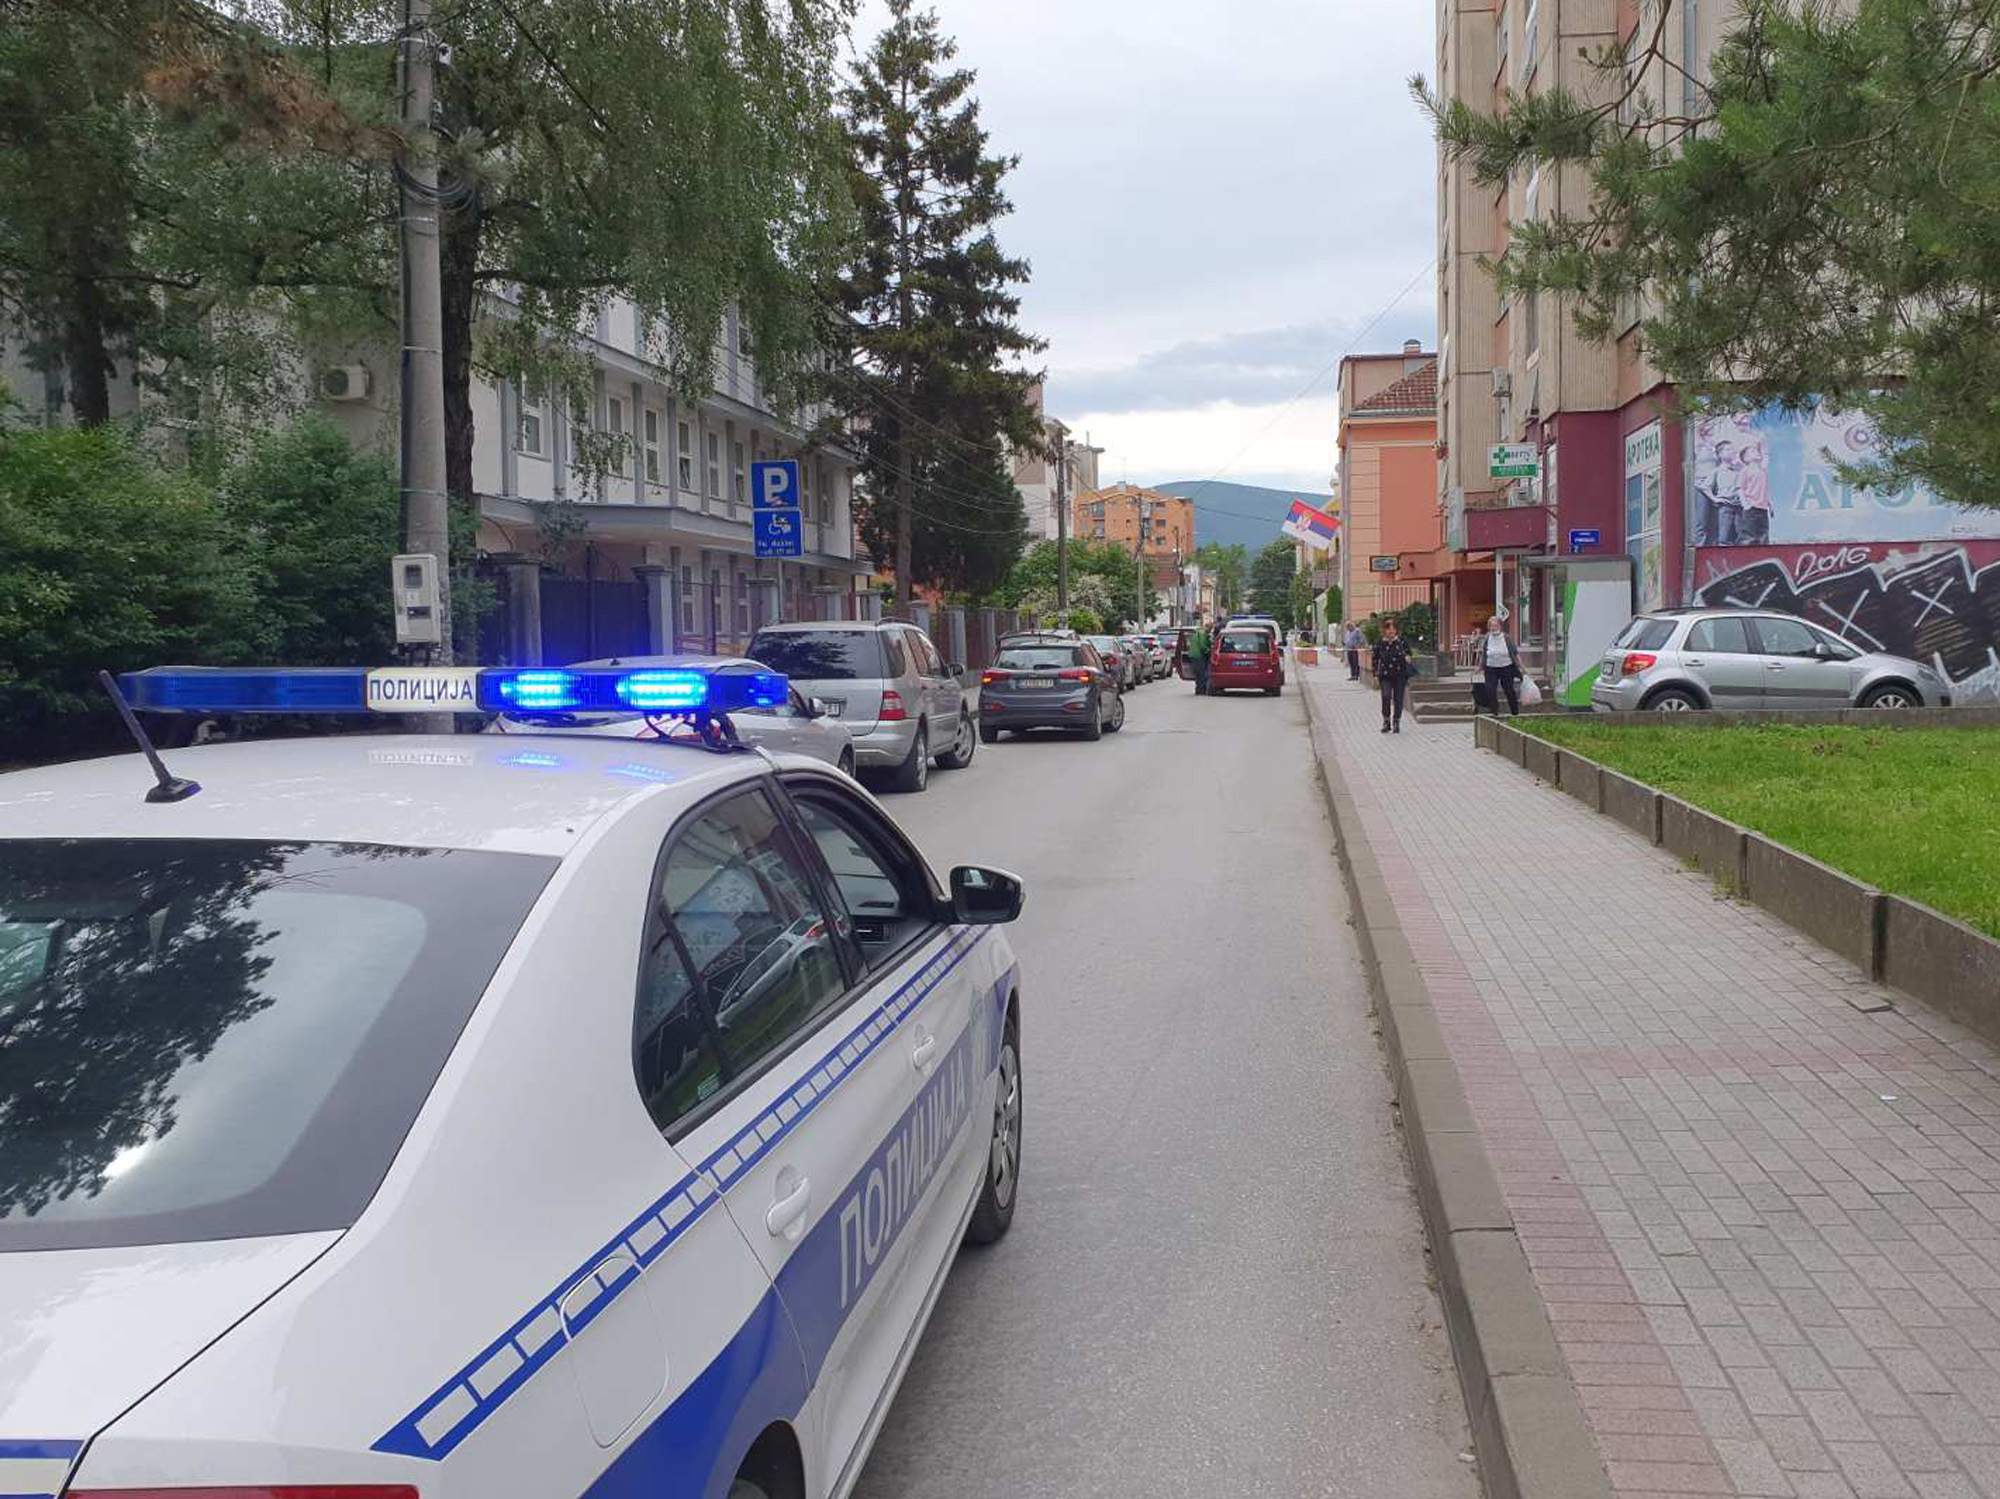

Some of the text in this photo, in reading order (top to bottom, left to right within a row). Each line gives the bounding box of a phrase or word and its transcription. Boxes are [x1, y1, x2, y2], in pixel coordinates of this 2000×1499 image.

[1627, 431, 1660, 467] APOTEKA
[763, 467, 788, 504] P
[369, 678, 473, 704] ПОЛИЦИЈА
[840, 1048, 966, 1309] ПОЛИЦИЈА
